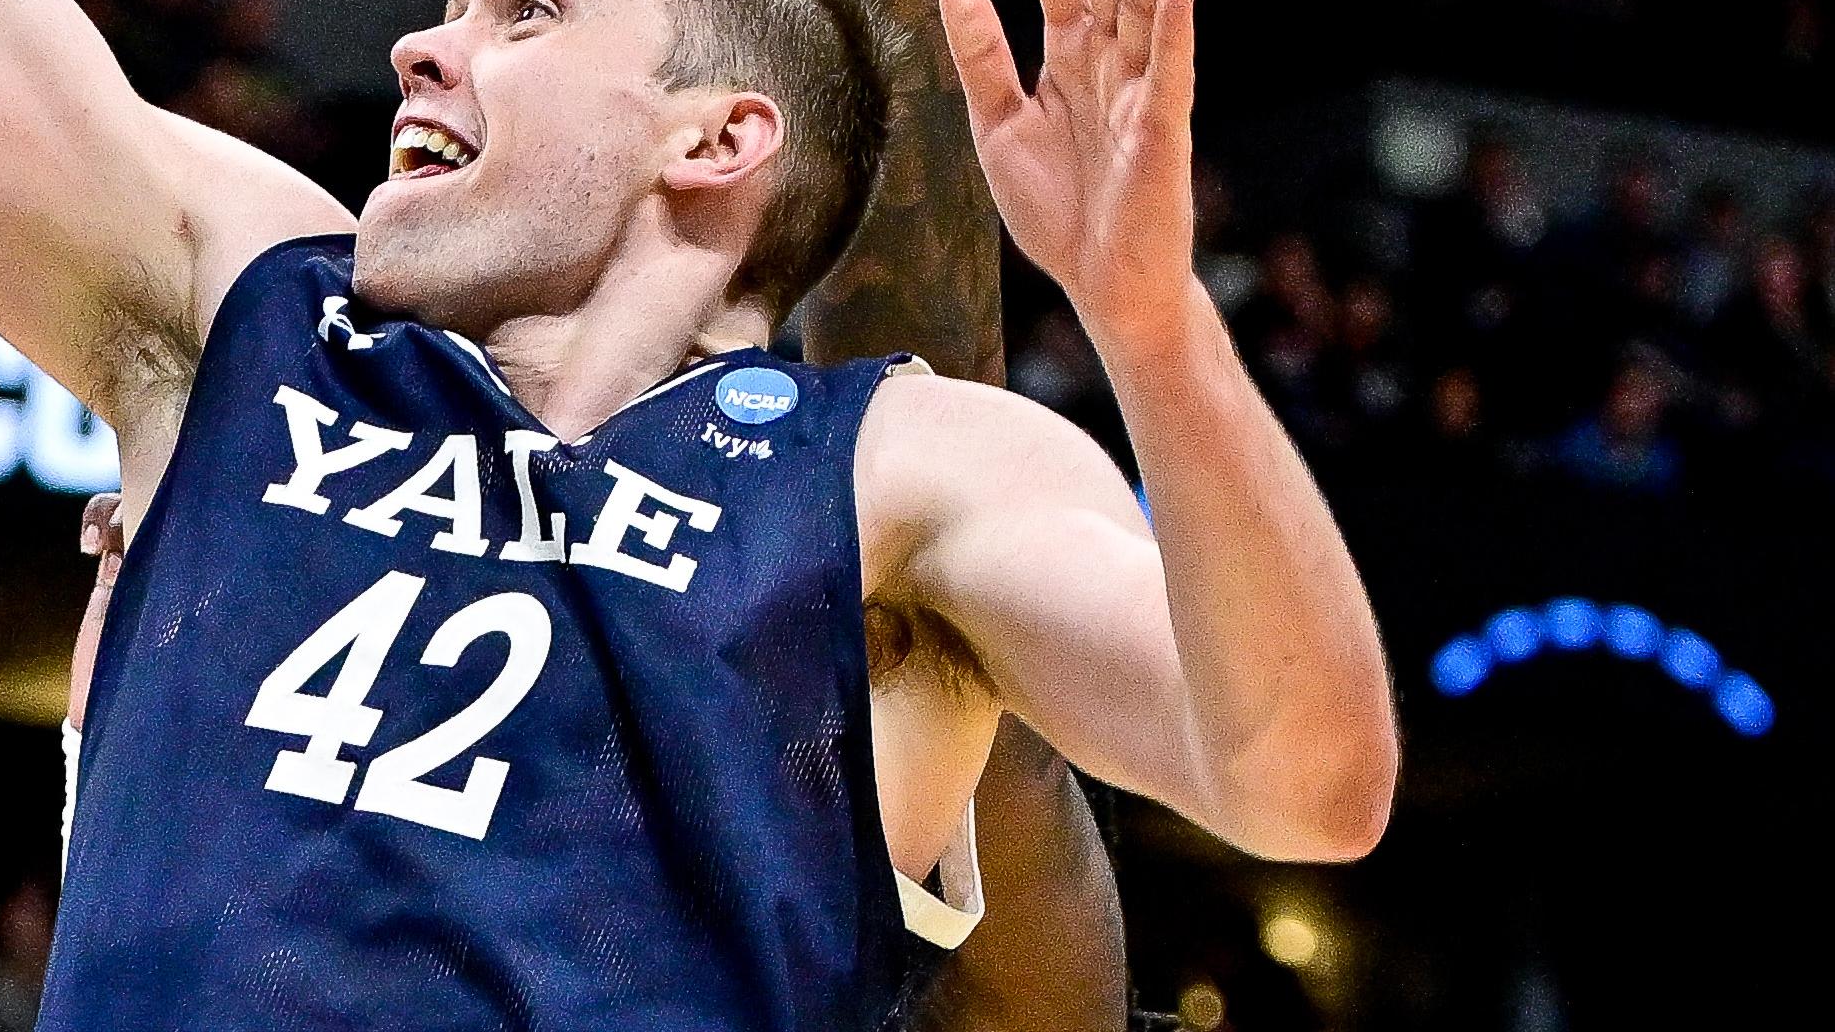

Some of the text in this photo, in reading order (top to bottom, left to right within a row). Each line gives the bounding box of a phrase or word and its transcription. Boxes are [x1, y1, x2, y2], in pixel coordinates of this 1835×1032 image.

[262, 385, 722, 593] YALE
[725, 388, 791, 411] NCAA
[244, 569, 553, 841] 42
